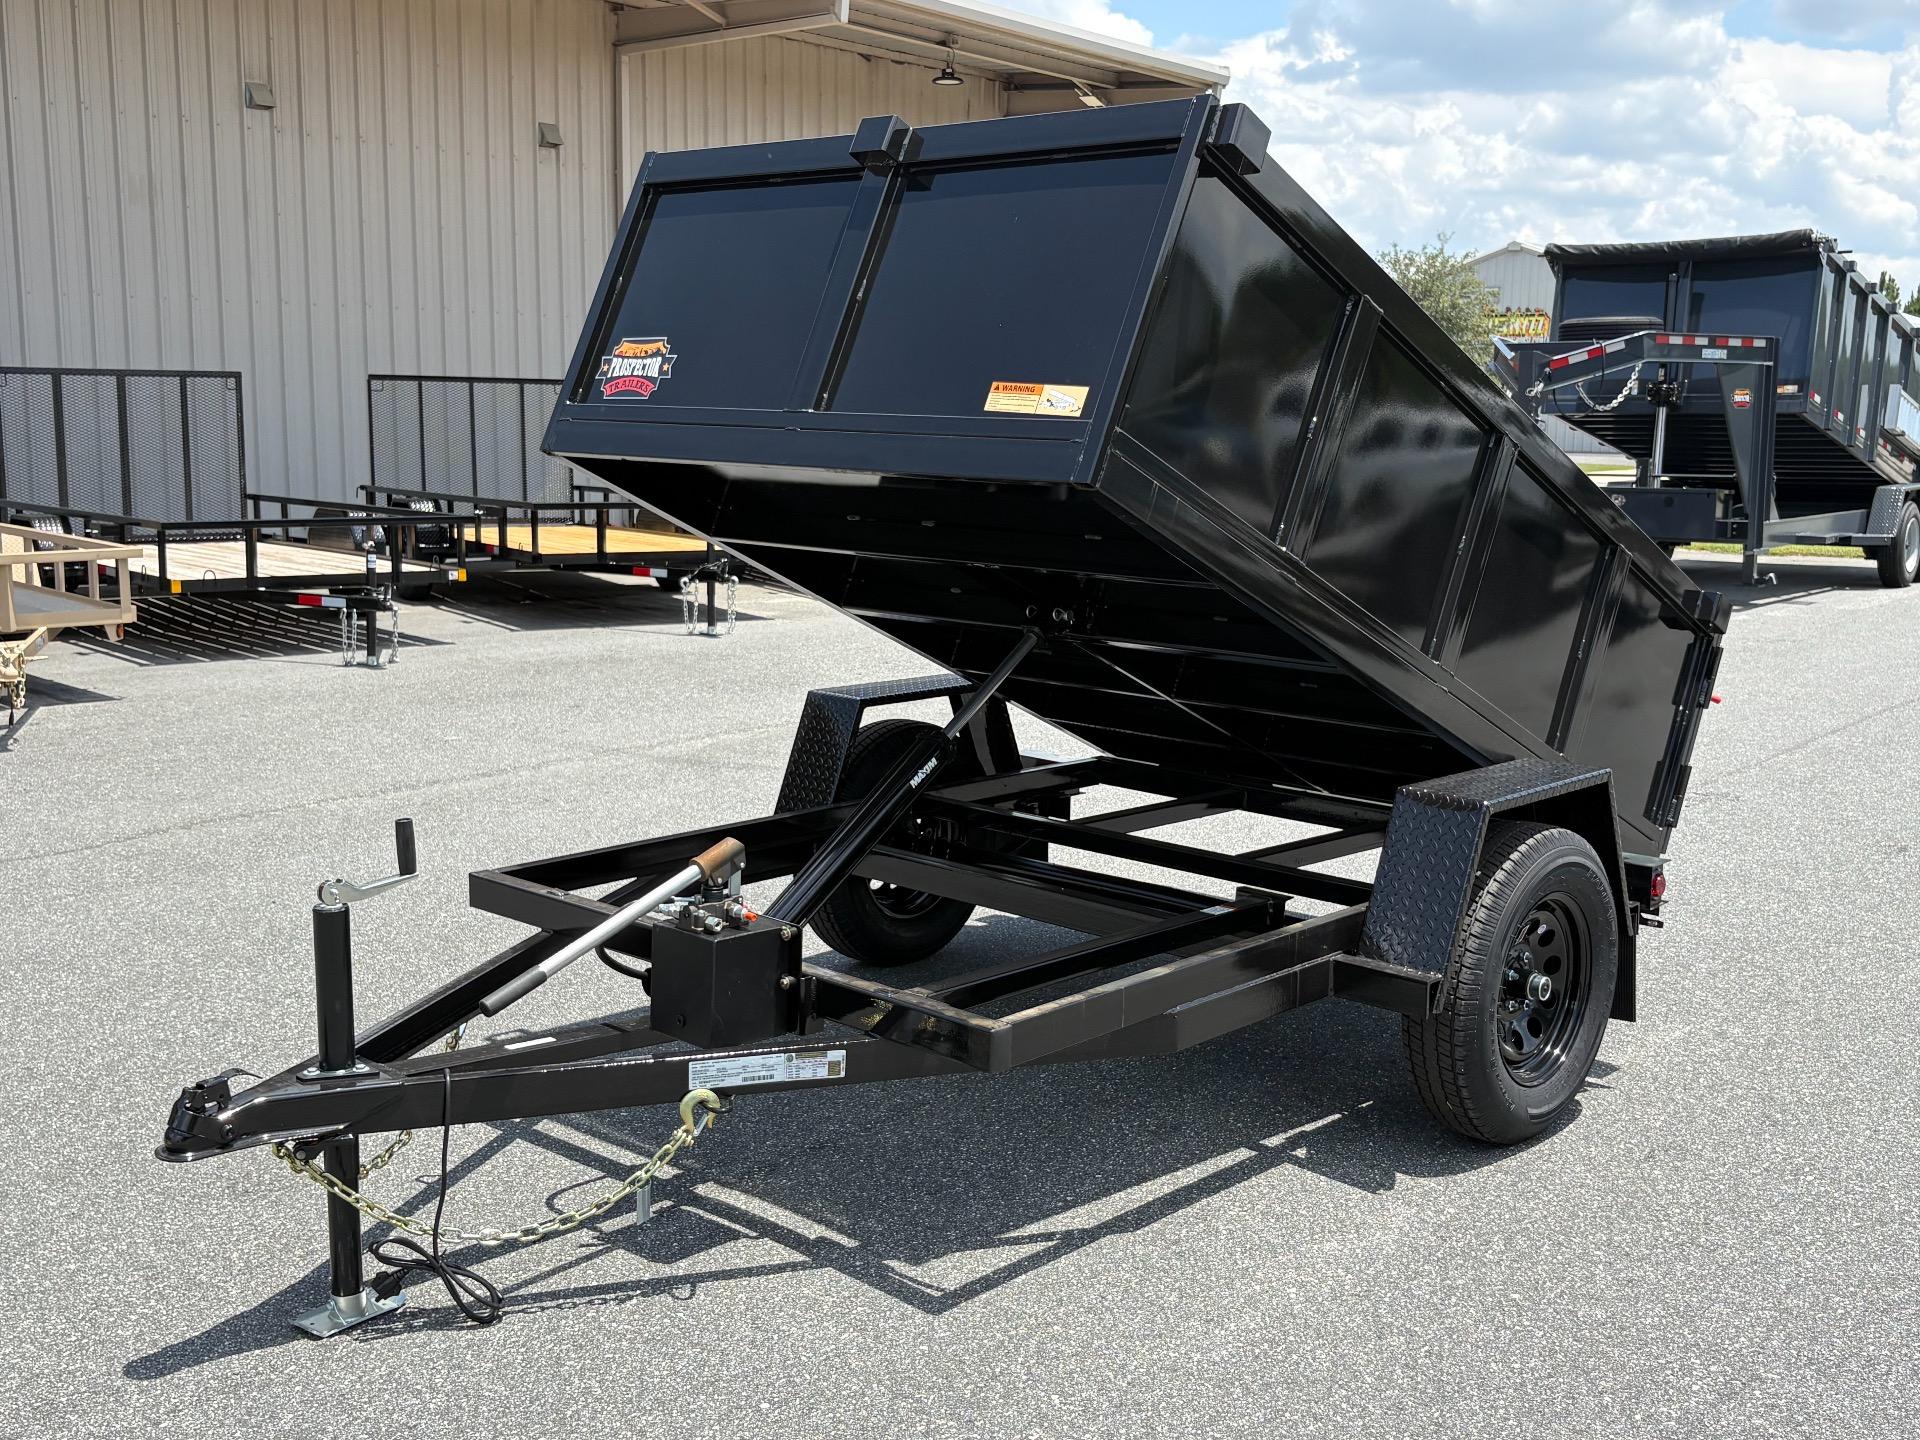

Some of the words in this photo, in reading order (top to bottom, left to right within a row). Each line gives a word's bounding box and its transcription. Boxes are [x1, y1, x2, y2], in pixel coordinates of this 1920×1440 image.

[606, 356, 663, 378] PROSPECTOR
[608, 379, 651, 393] TRAILERS
[1001, 384, 1036, 393] WARNING
[909, 756, 938, 789] MAXIM
